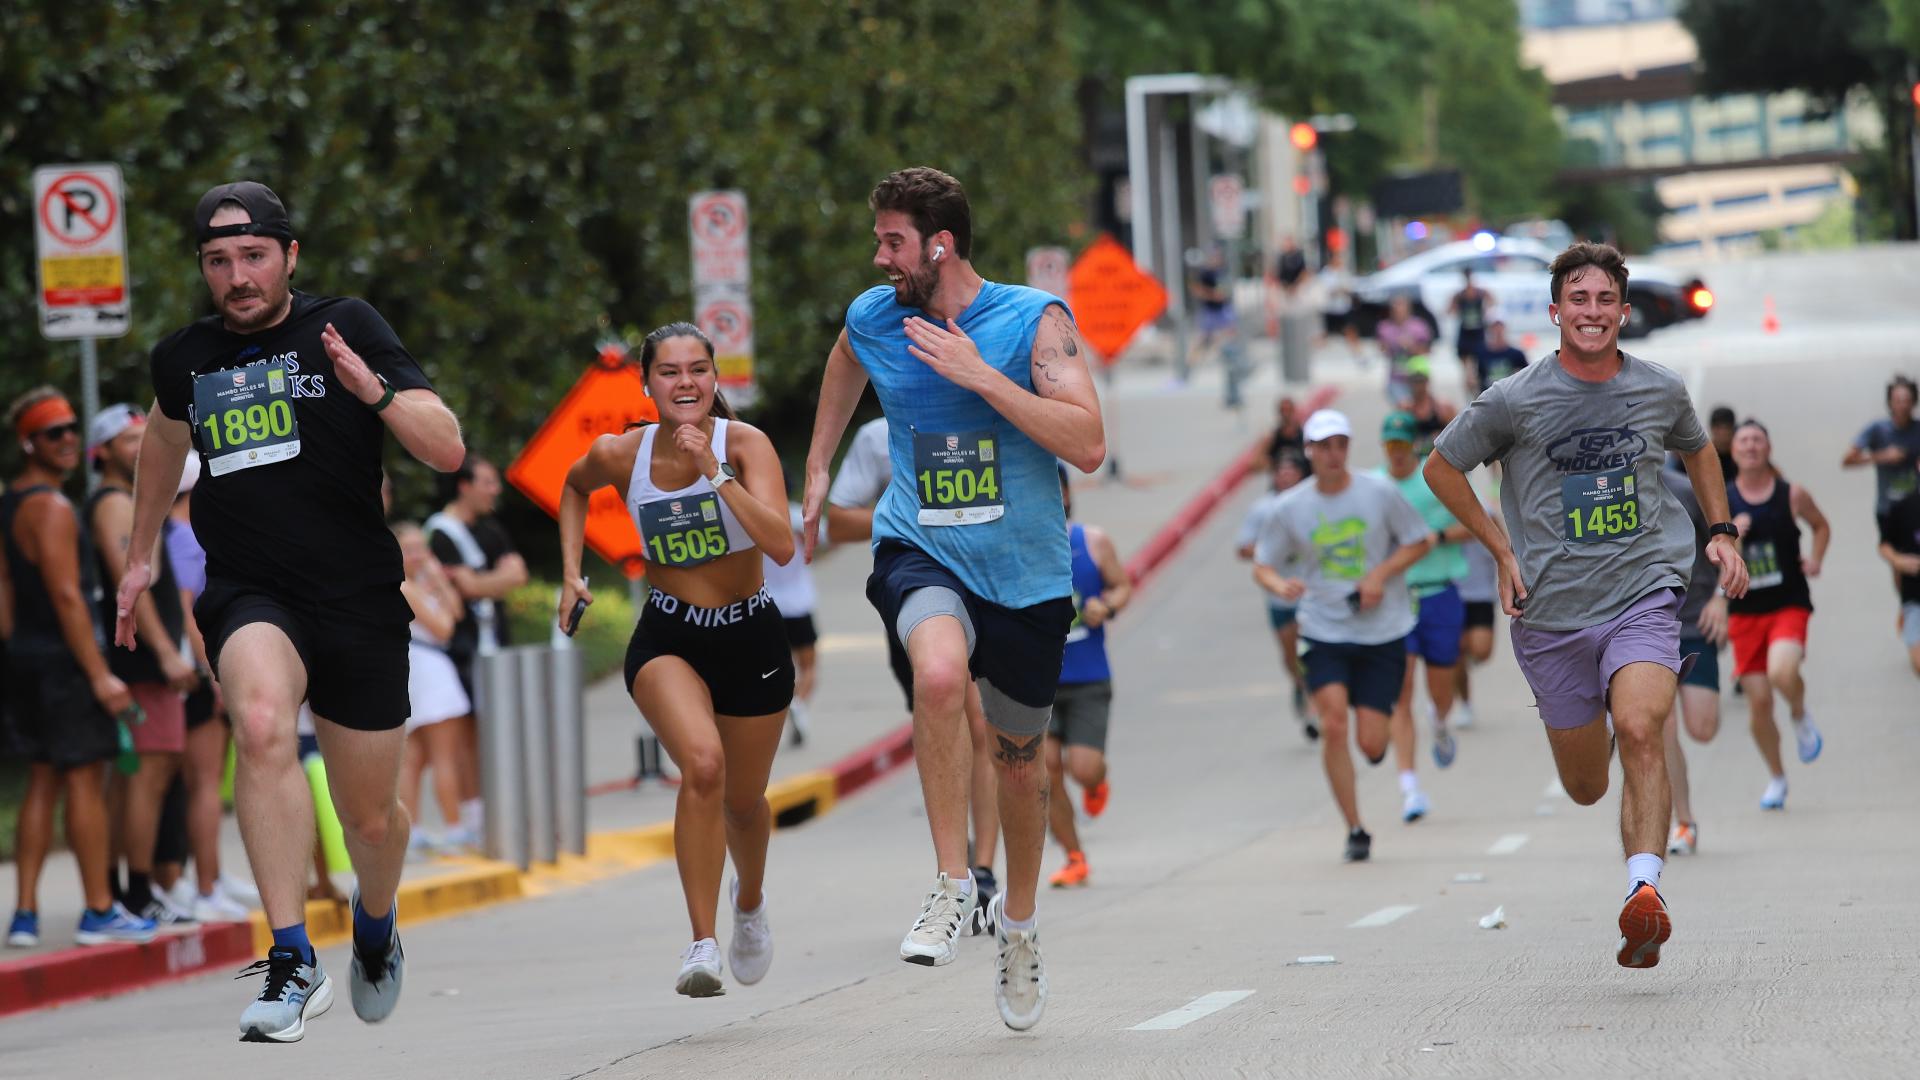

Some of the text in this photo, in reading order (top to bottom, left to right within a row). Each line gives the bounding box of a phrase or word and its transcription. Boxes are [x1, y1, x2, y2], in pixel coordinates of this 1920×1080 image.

[217, 389, 239, 398] MAMBO
[240, 384, 257, 393] MILES
[203, 399, 292, 450] 1890
[1578, 434, 1616, 452] USA
[1556, 452, 1636, 471] HOCKEY
[919, 466, 998, 504] 1504
[1568, 500, 1638, 538] 1453
[649, 526, 726, 564] 1505
[684, 601, 743, 627] NIKE
